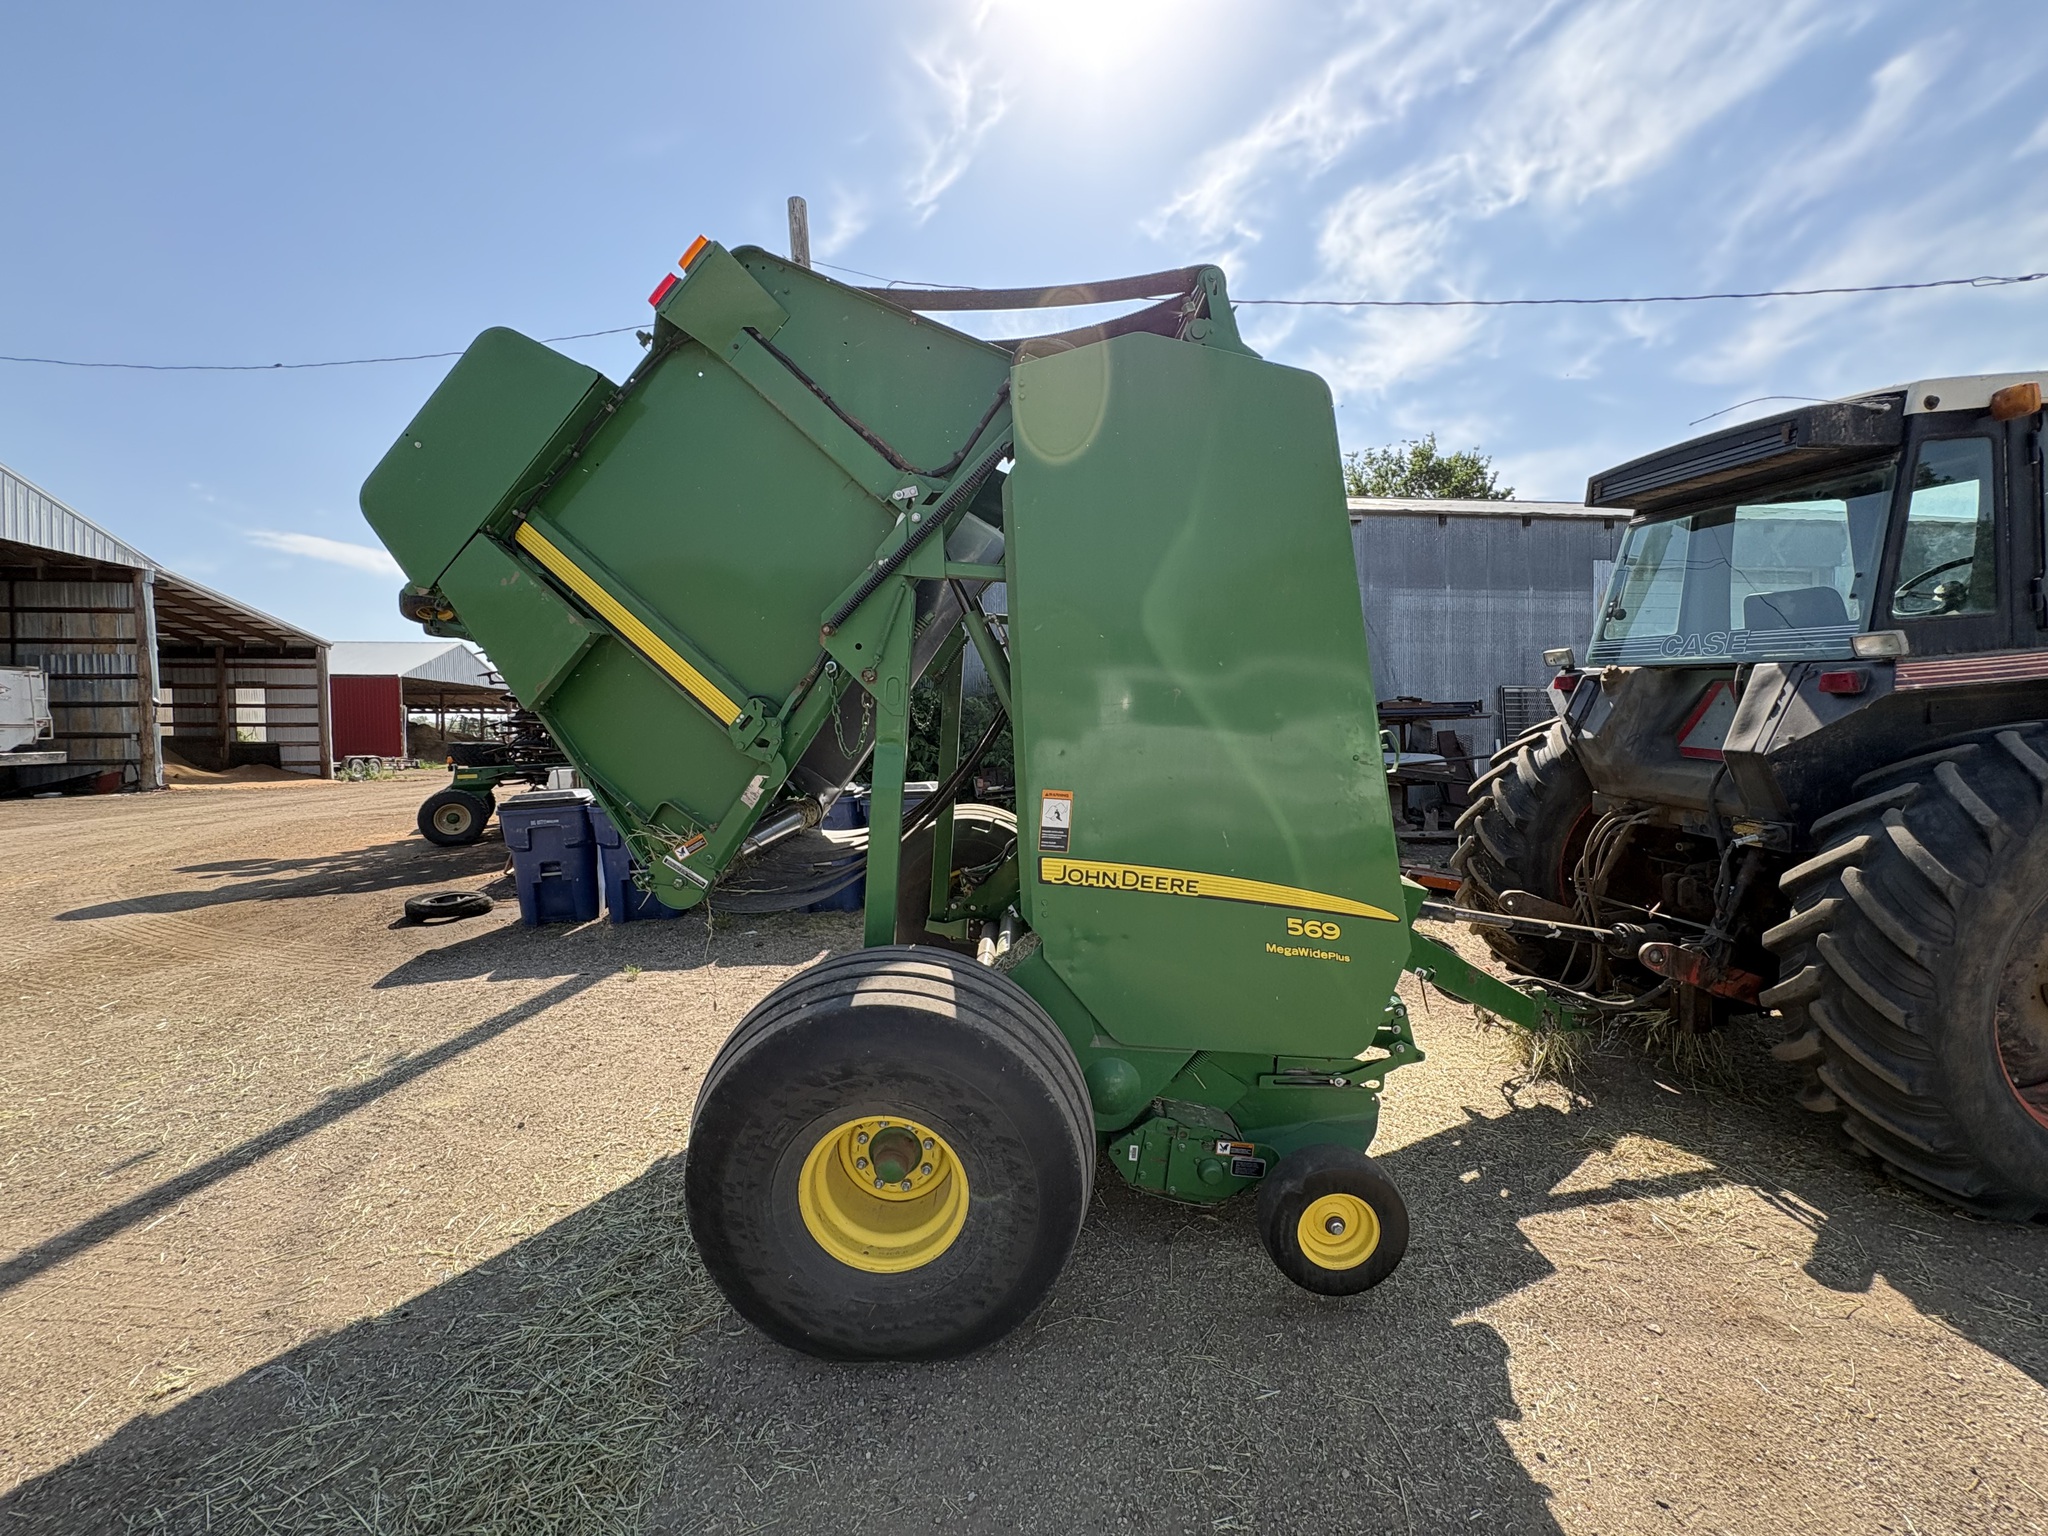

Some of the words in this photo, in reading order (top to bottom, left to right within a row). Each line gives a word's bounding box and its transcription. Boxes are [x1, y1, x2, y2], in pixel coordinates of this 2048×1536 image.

[1660, 630, 1750, 658] CASE
[1054, 864, 1117, 886] JOHN
[1121, 870, 1199, 894] DEERE
[1286, 917, 1341, 940] 569
[1265, 942, 1351, 963] MegaWidePlus
